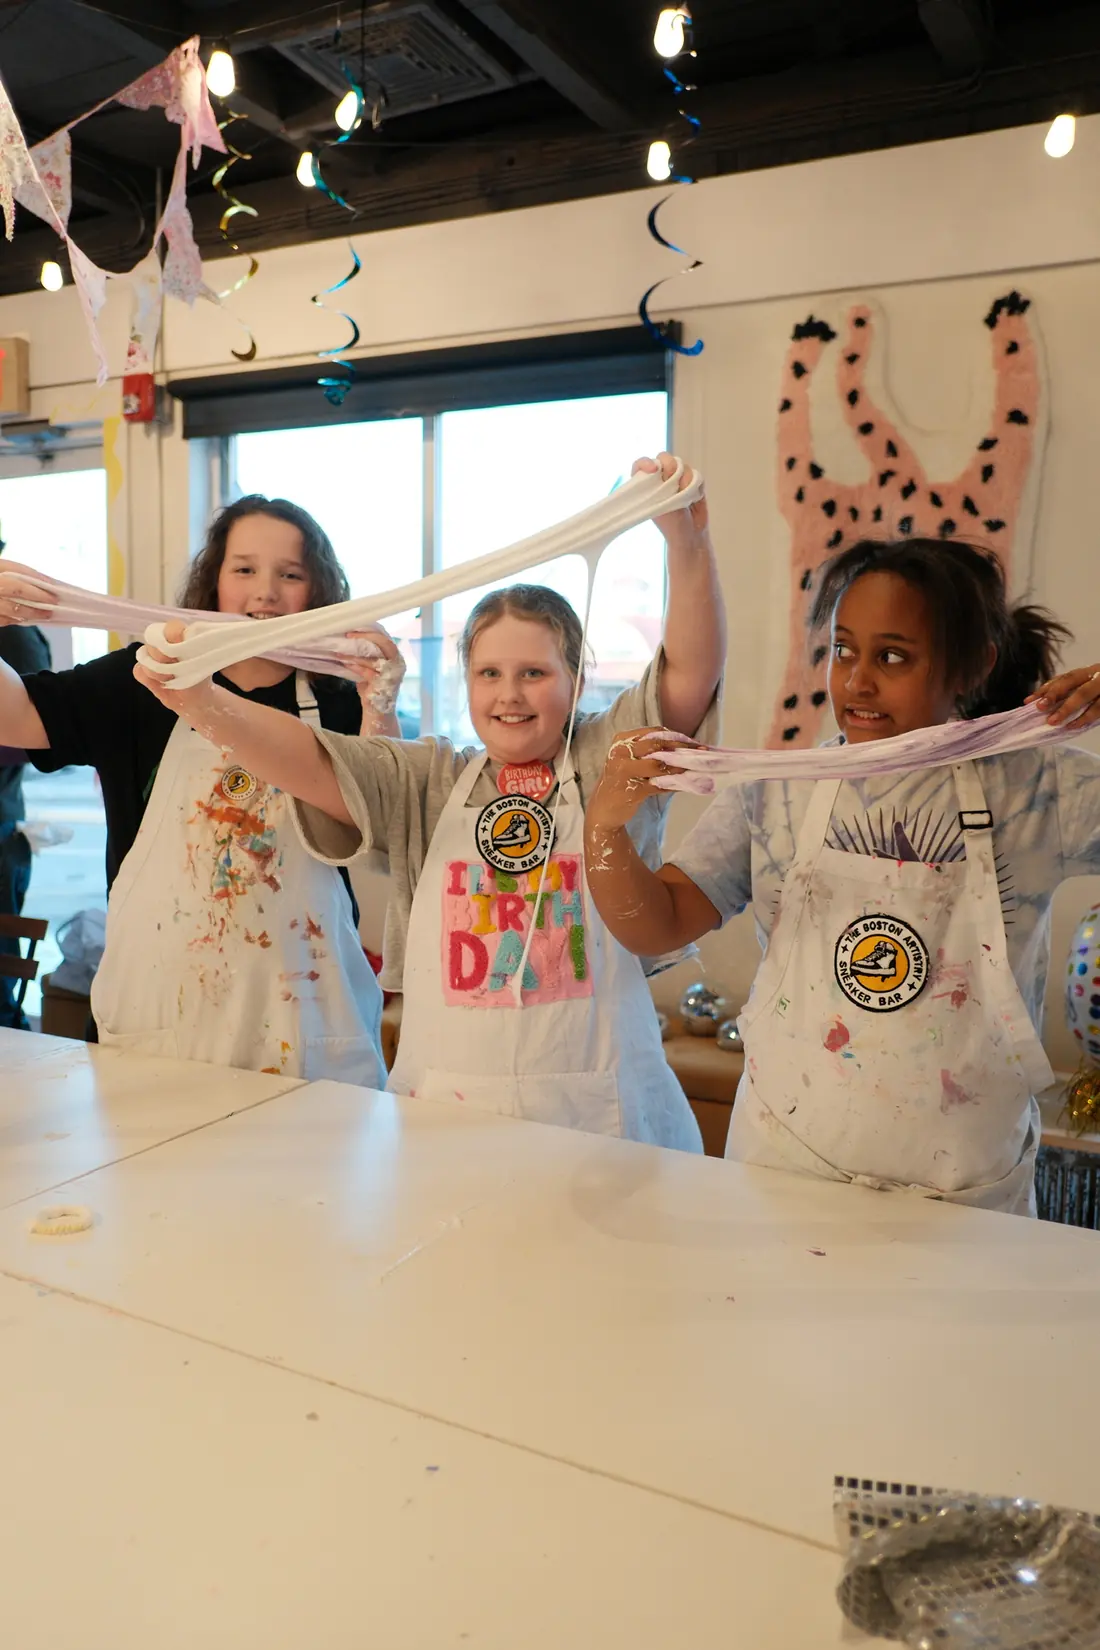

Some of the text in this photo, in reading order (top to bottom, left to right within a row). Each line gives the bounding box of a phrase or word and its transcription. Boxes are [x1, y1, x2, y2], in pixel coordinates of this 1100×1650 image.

[505, 765, 543, 781] BIRTHDAY
[483, 799, 551, 840] THE BOSTON ARTISTRY
[481, 840, 540, 869] SNEAKER BAR
[527, 860, 577, 892] MY
[450, 889, 583, 934] BIRTH
[845, 921, 924, 981] THE BOSTON ARTISTRY
[839, 961, 903, 1006] SNEAKER BAR
